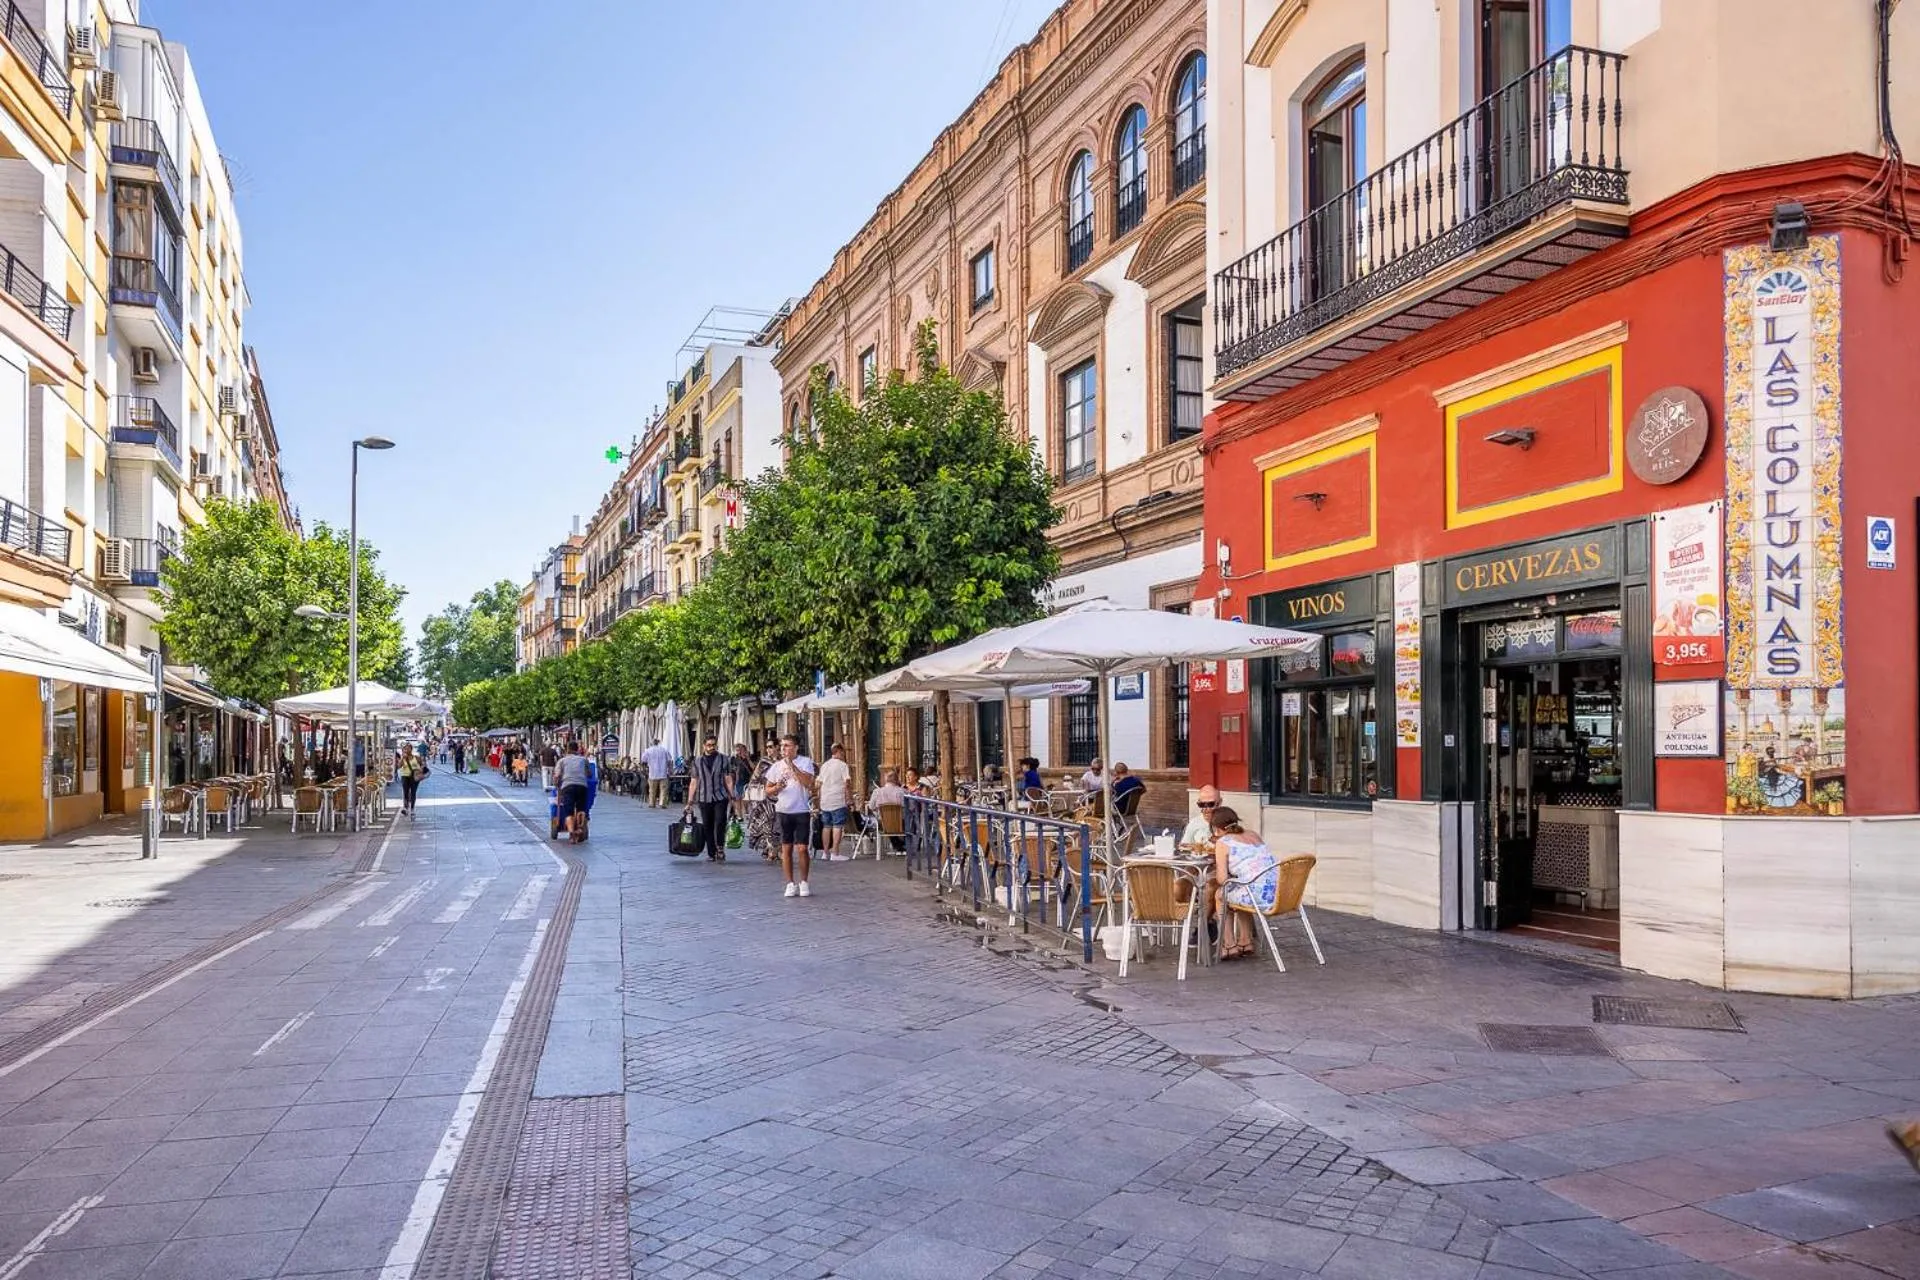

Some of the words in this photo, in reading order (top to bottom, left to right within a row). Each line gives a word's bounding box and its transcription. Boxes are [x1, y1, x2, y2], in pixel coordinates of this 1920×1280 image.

[1763, 316, 1799, 408] LAS
[1455, 543, 1602, 592] CERVEZAS
[1763, 423, 1802, 675] COLUMNAS
[1288, 591, 1345, 620] VINOS
[1666, 643, 1708, 661] 3,95€
